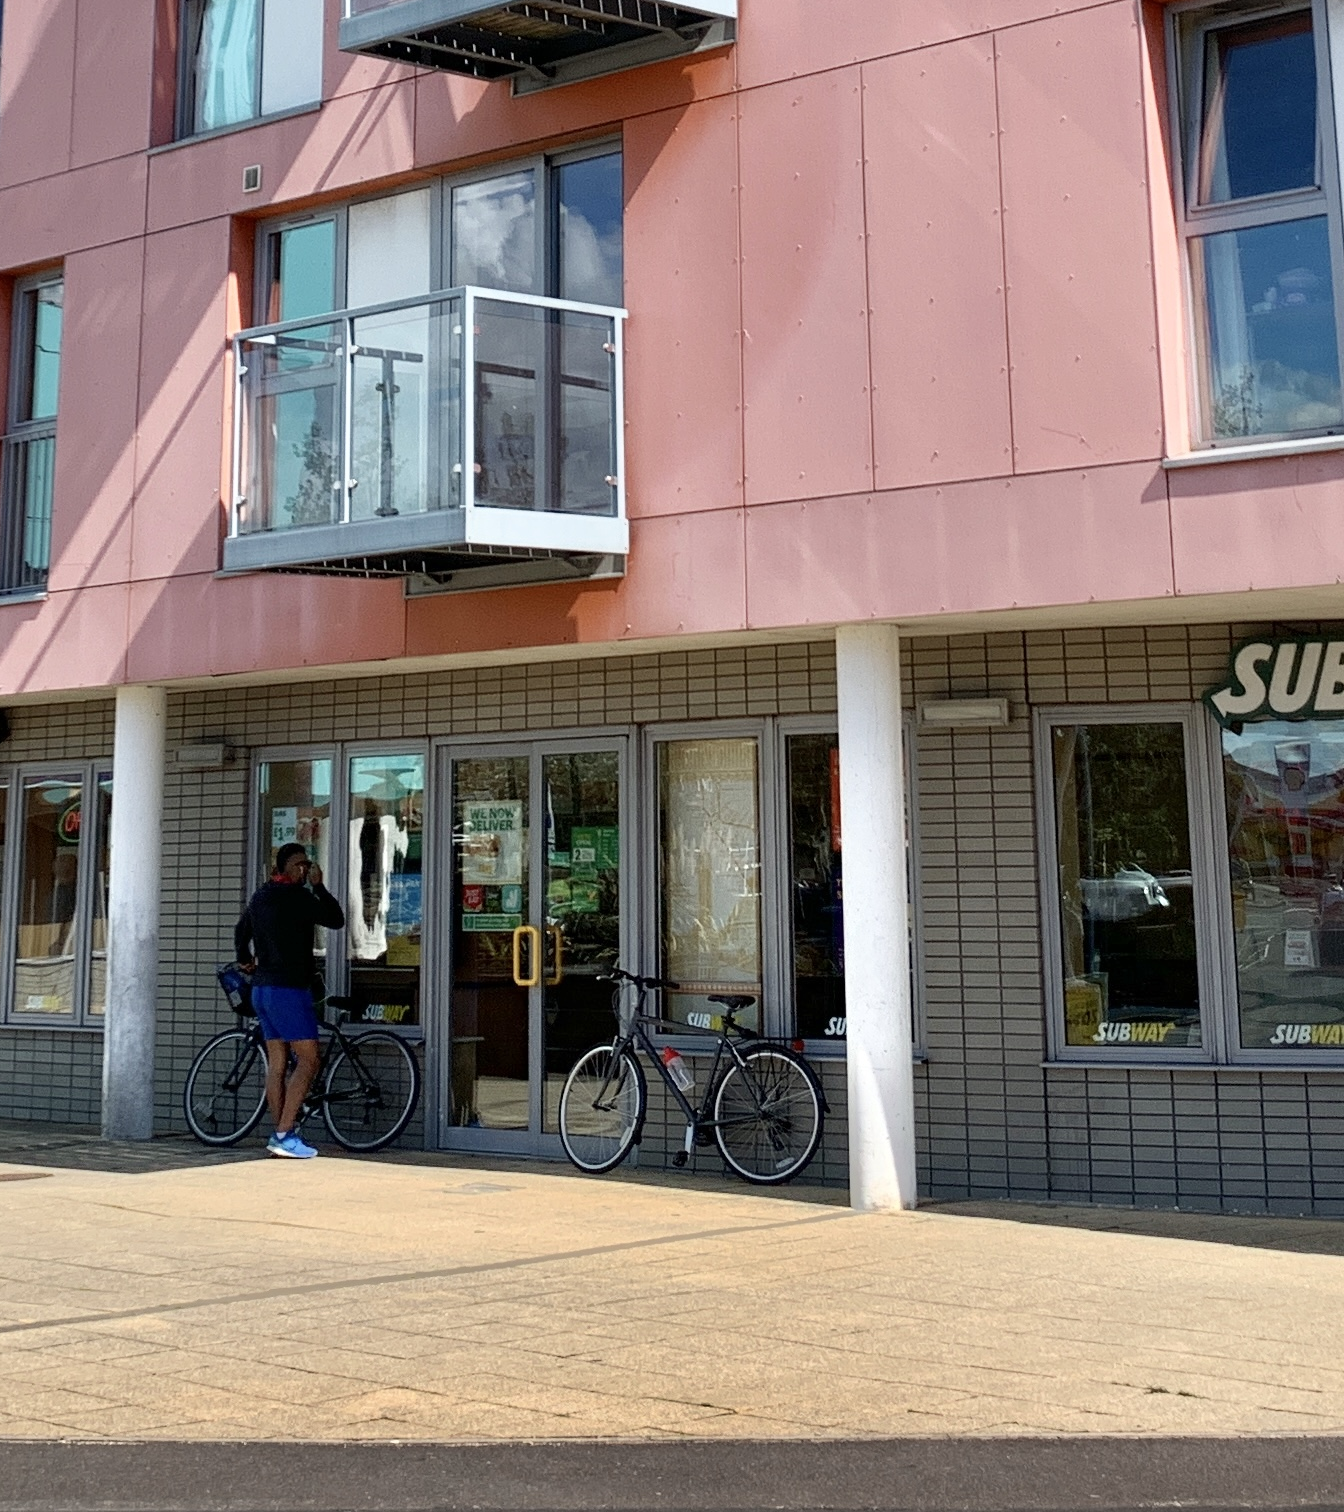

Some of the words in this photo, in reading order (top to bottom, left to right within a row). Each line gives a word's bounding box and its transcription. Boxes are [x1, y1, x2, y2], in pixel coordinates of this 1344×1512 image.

[470, 808, 487, 819] WE
[489, 807, 514, 819] NOW
[362, 1004, 410, 1021] SUBWAY
[1092, 1021, 1175, 1043] SUBWAY
